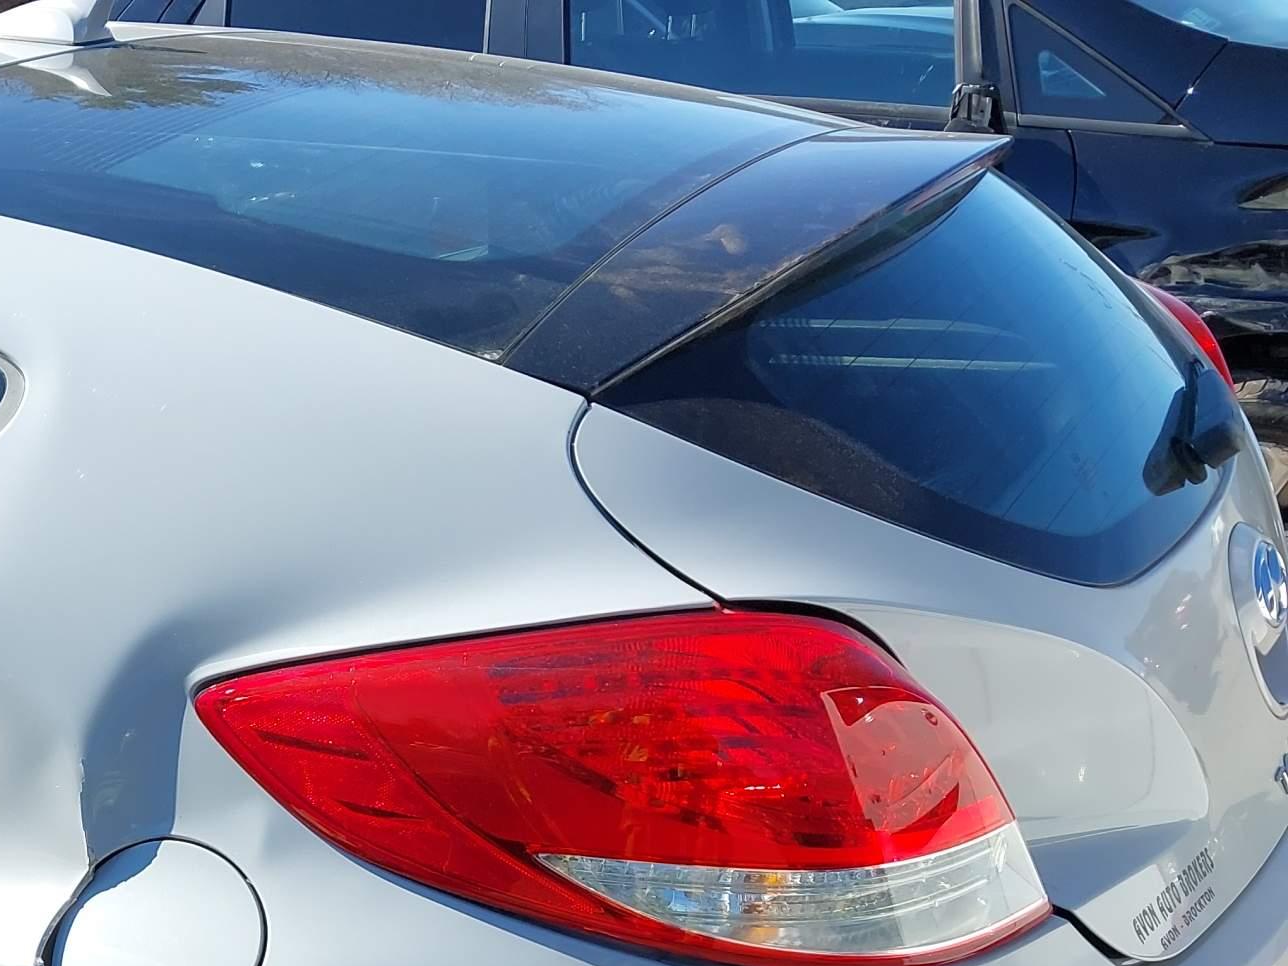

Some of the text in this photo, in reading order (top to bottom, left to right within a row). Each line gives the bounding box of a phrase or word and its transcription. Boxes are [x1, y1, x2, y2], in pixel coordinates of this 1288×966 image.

[1132, 847, 1215, 944] AVON AUTO BROKERS
[1160, 925, 1181, 950] AVON
[1182, 887, 1216, 927] BROCKTON
